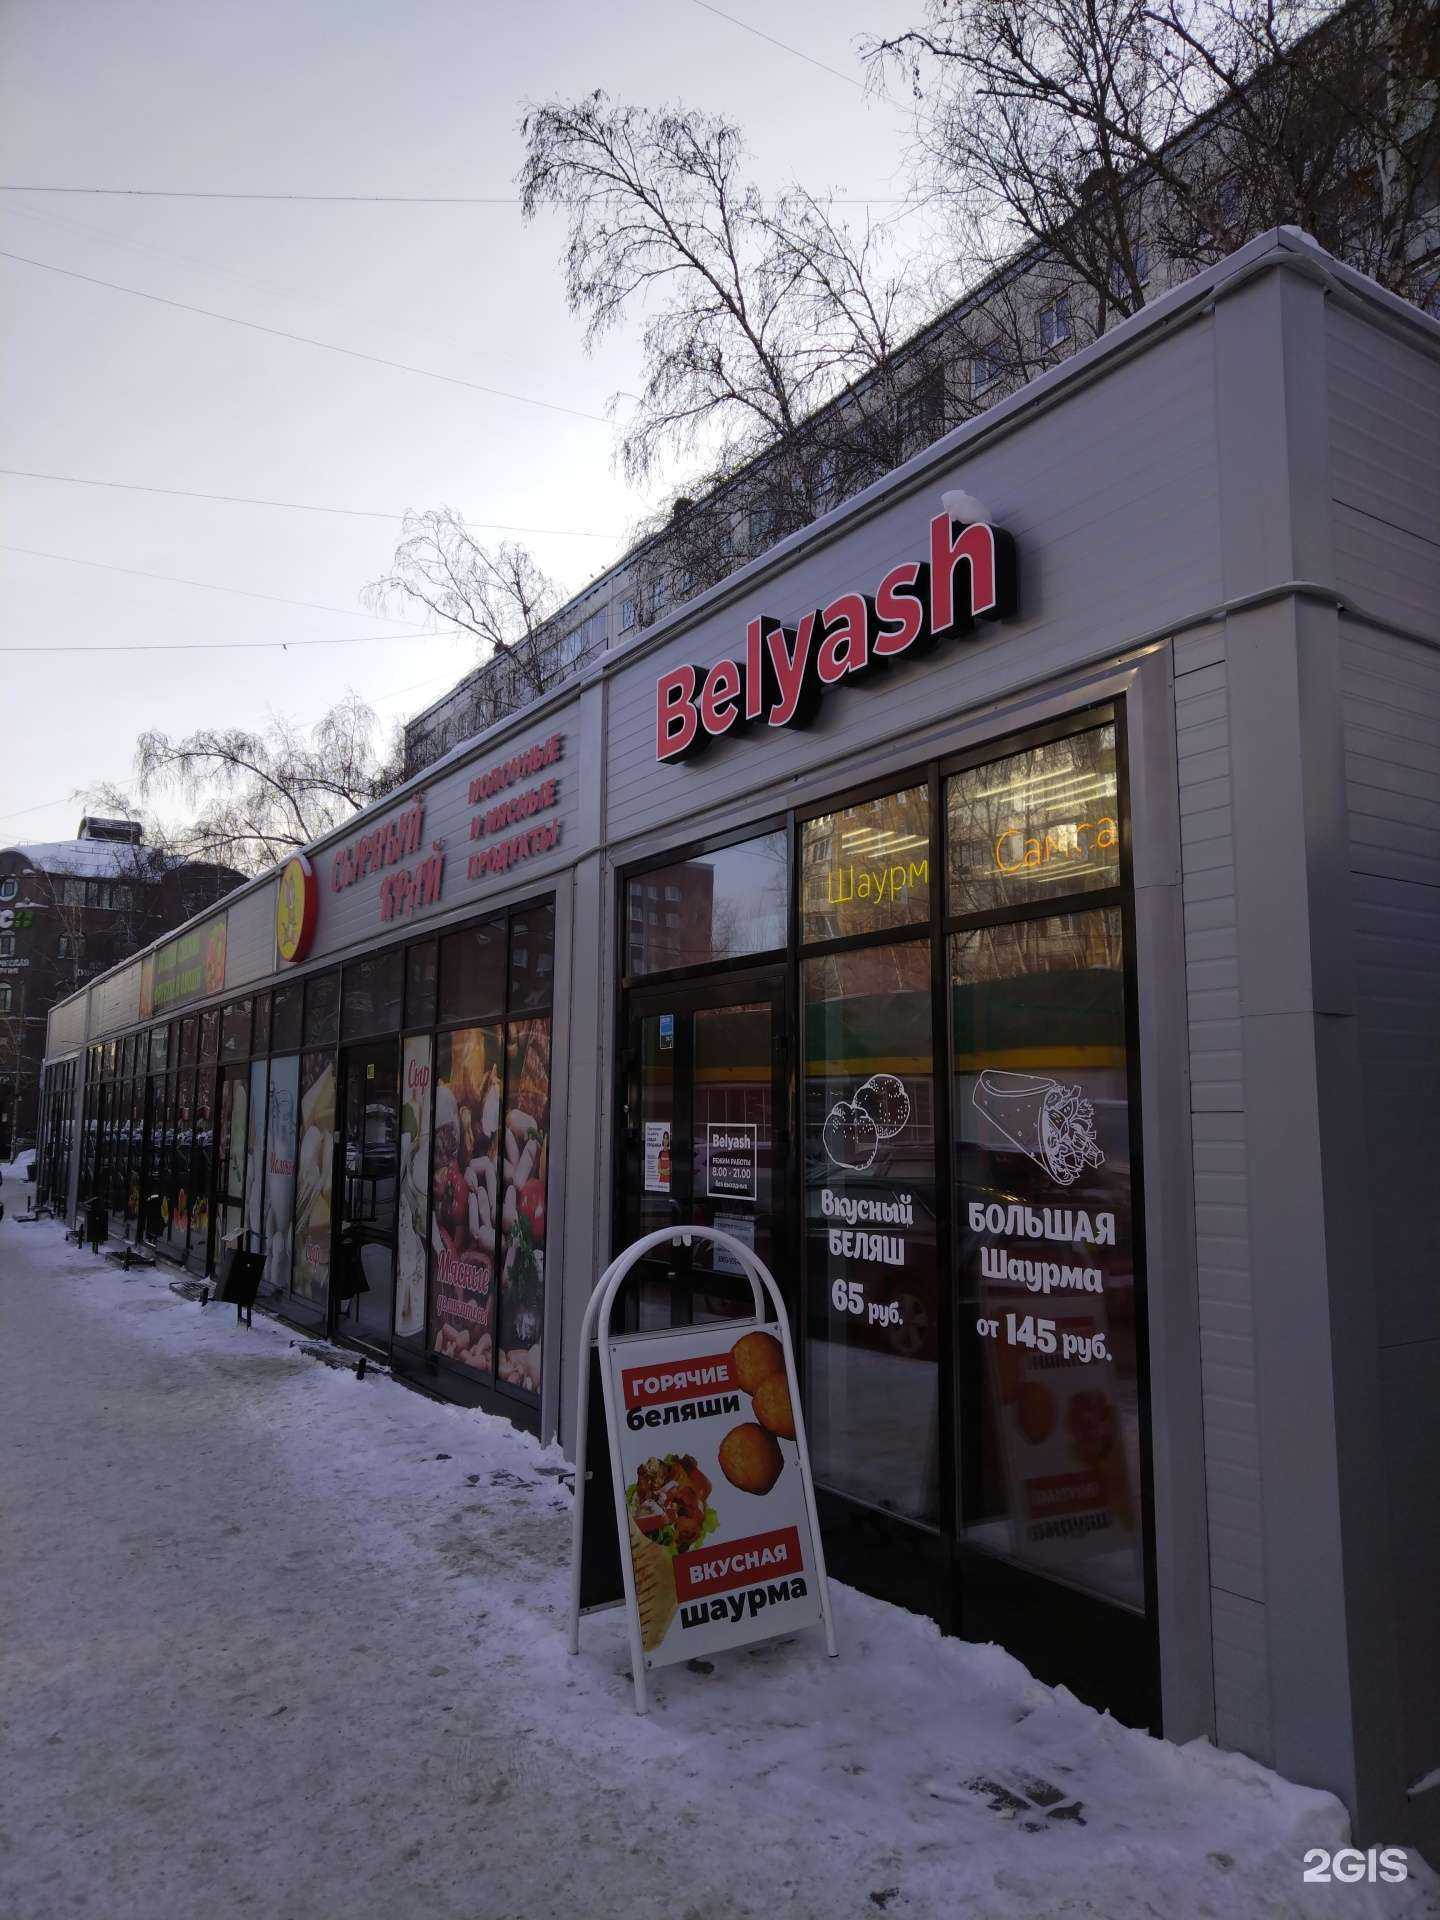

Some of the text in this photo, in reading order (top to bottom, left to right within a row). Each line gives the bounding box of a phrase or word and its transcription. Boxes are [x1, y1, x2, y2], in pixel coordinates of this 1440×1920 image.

[655, 511, 998, 765] Belyash
[331, 790, 425, 894] СЫРНЫЙ
[466, 816, 560, 881] ПРОДУКТЫ
[380, 838, 446, 922] КРАЙ
[828, 859, 929, 905] Шаурм
[408, 1058, 430, 1096] Сыр
[712, 1133, 751, 1150] Belyash
[821, 1189, 914, 1228] Вкусный
[969, 1202, 1116, 1246] БОЛЬШАЯ
[829, 1229, 905, 1266] БЕЛЯШ
[980, 1246, 1104, 1294] Шаурма
[832, 1278, 904, 1327] 65 руб.
[977, 1318, 1000, 1338] от
[1006, 1312, 1057, 1354] 145
[1062, 1332, 1113, 1363] руб.
[632, 1364, 730, 1397] ГОРЯЧИЕ
[626, 1394, 742, 1431] беляши
[689, 1543, 788, 1585] ВКУСНАЯ
[680, 1576, 808, 1630] шаурма
